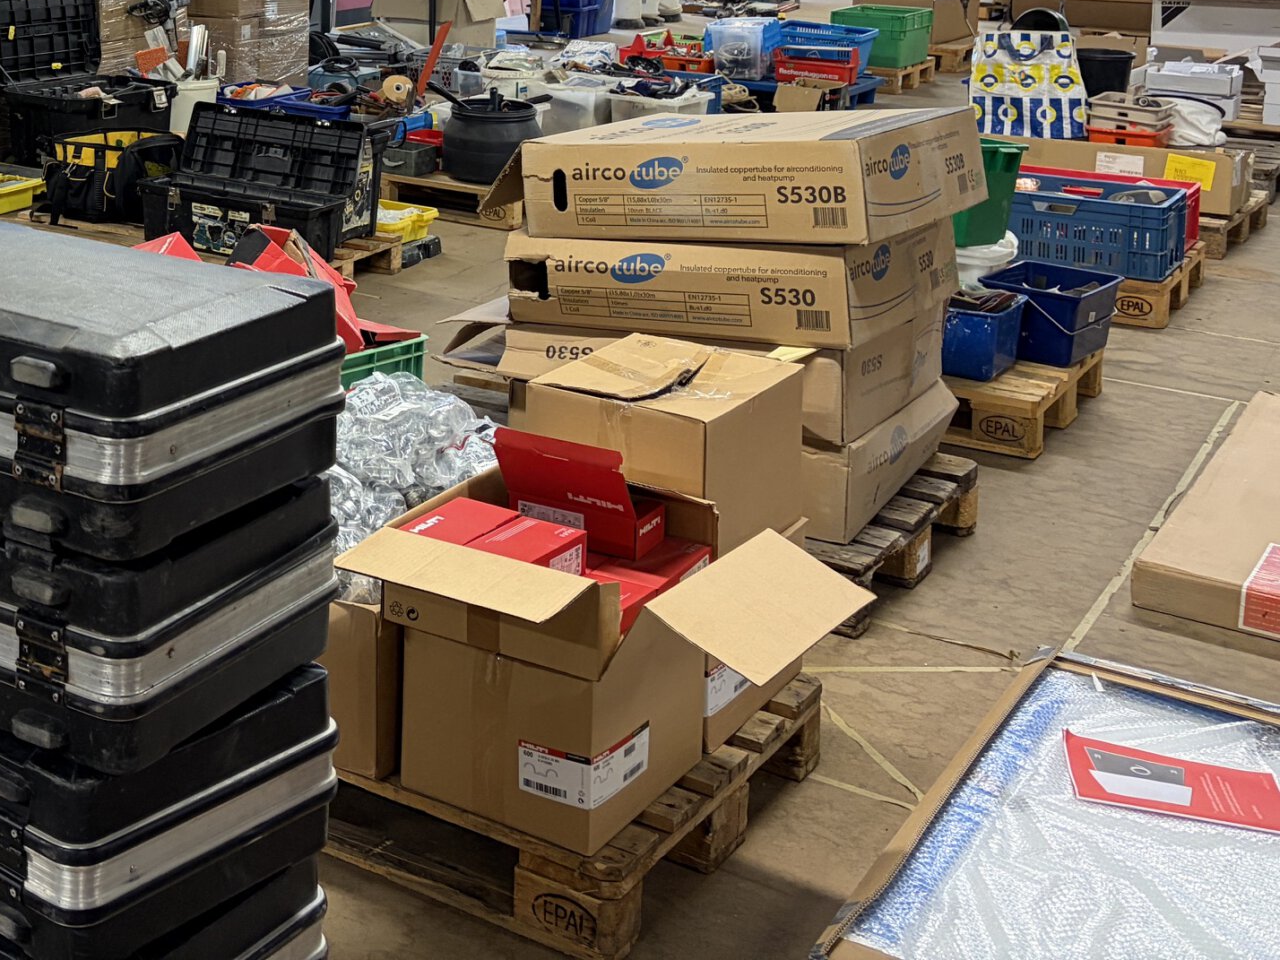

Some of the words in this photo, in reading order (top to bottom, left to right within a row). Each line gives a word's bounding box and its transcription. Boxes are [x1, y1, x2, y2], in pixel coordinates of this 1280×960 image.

[572, 162, 626, 181] airco
[633, 160, 681, 181] tube
[696, 165, 728, 174] Insulated
[730, 165, 772, 175] coppertube
[774, 165, 785, 173] for
[786, 165, 843, 174] airconditioning
[865, 157, 888, 178] airco
[890, 149, 910, 172] tube
[945, 153, 965, 174] S530B
[742, 174, 756, 182] and
[757, 174, 795, 182] heatpump
[777, 186, 846, 204] S530B
[554, 255, 608, 275] airco
[614, 257, 663, 276] tube
[680, 264, 712, 273] Insulated
[714, 265, 756, 275] coppertube
[758, 266, 769, 274] for
[770, 266, 827, 278] airconditioning
[849, 259, 870, 281] airco
[741, 275, 779, 284] heatpump
[760, 287, 816, 307] S530
[1120, 300, 1146, 313] EPAL
[985, 420, 1018, 438] EPAL
[567, 492, 624, 512] HILTI
[410, 515, 446, 534] HILTI
[639, 515, 661, 537] HILTI
[521, 742, 548, 754] HILTI
